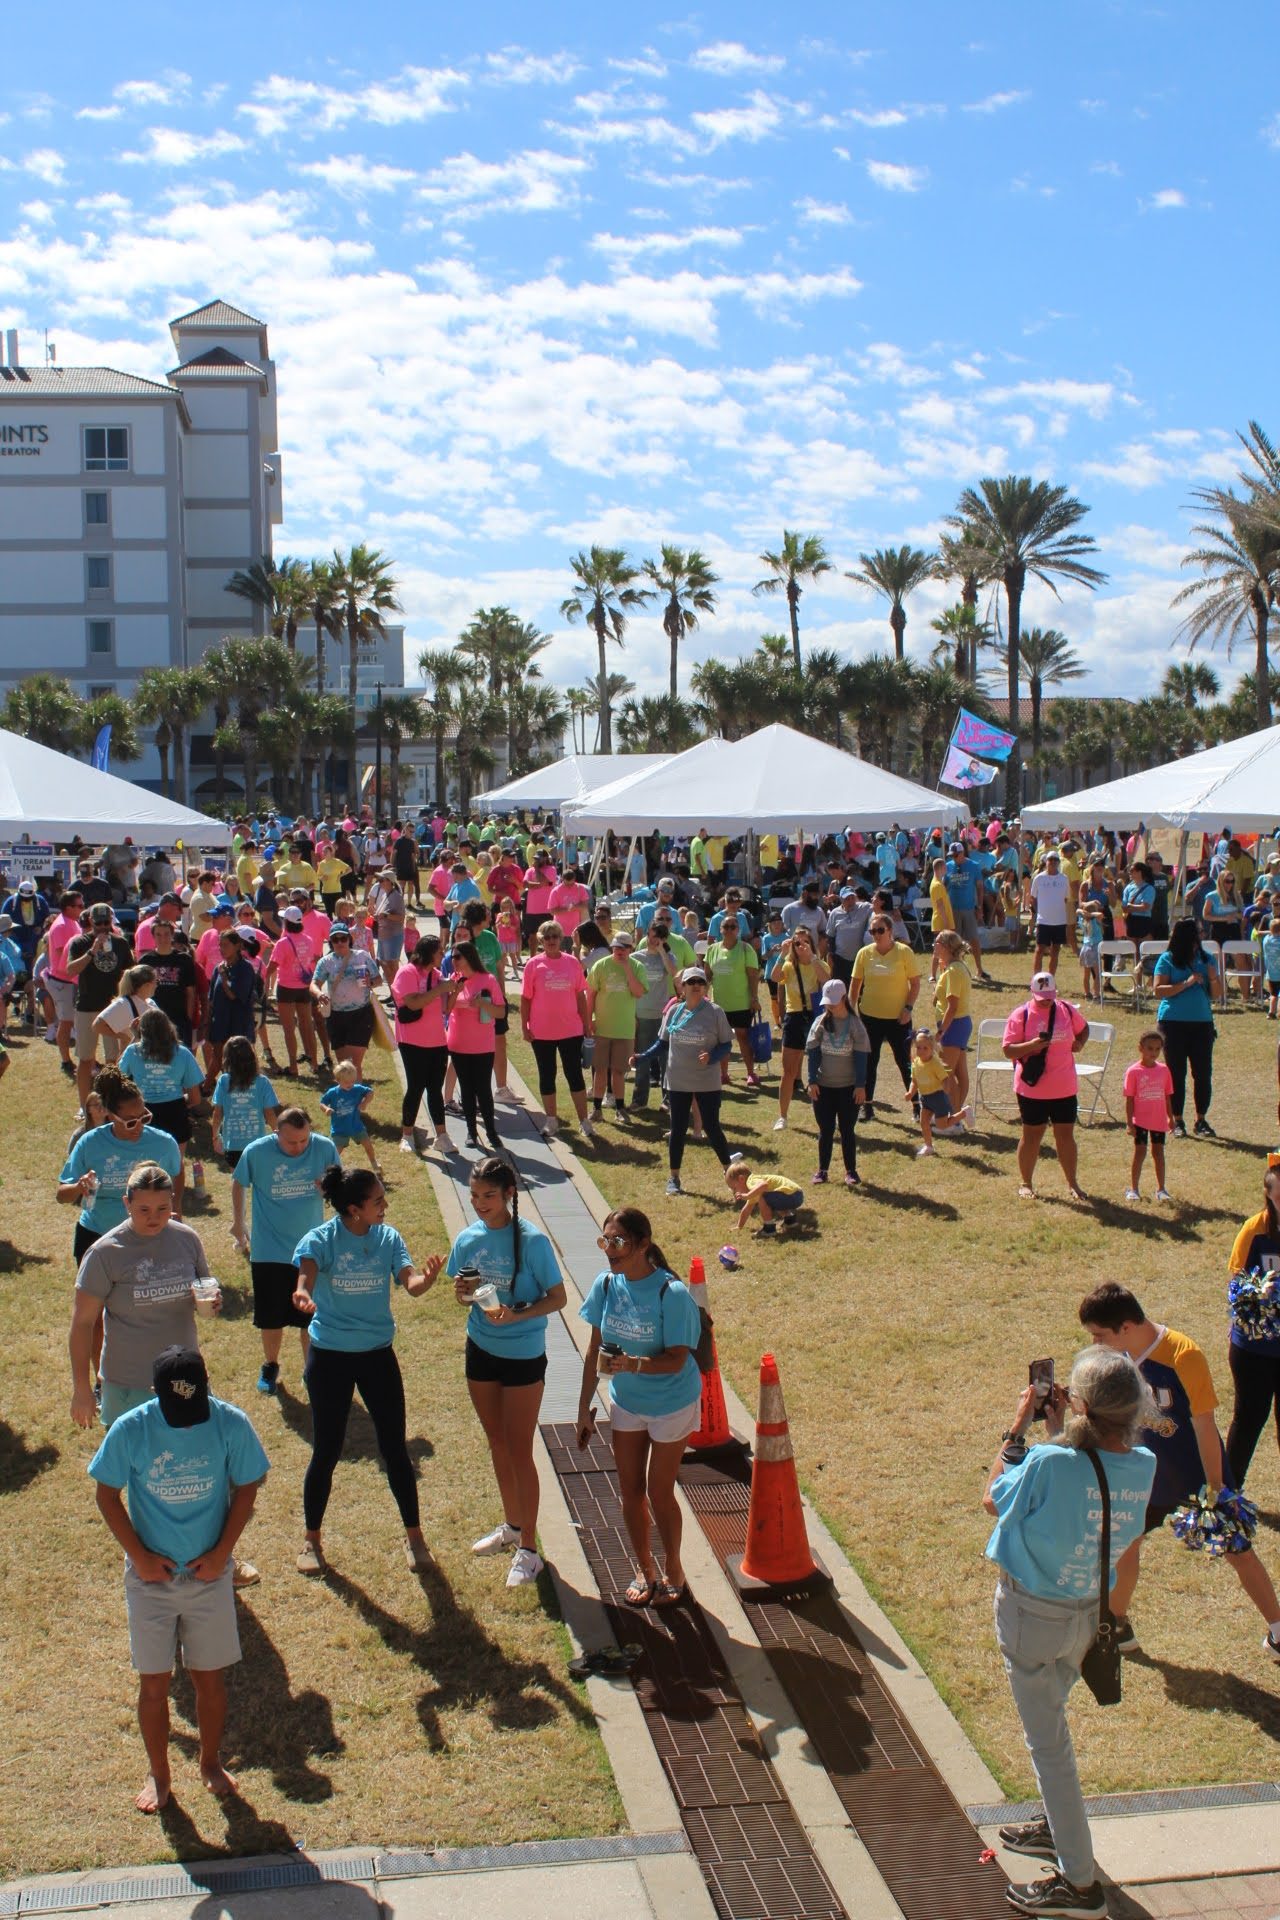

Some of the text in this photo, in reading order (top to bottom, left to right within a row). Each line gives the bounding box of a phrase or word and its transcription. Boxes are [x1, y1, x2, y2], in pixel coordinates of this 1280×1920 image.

[0, 424, 49, 443] INTS
[0, 447, 41, 456] ERATON
[102, 1176, 128, 1184] BUDDY
[271, 1183, 316, 1194] BUDDYWALK
[331, 1277, 384, 1288] BUDDYWALK
[1086, 1487, 1118, 1501] Tem
